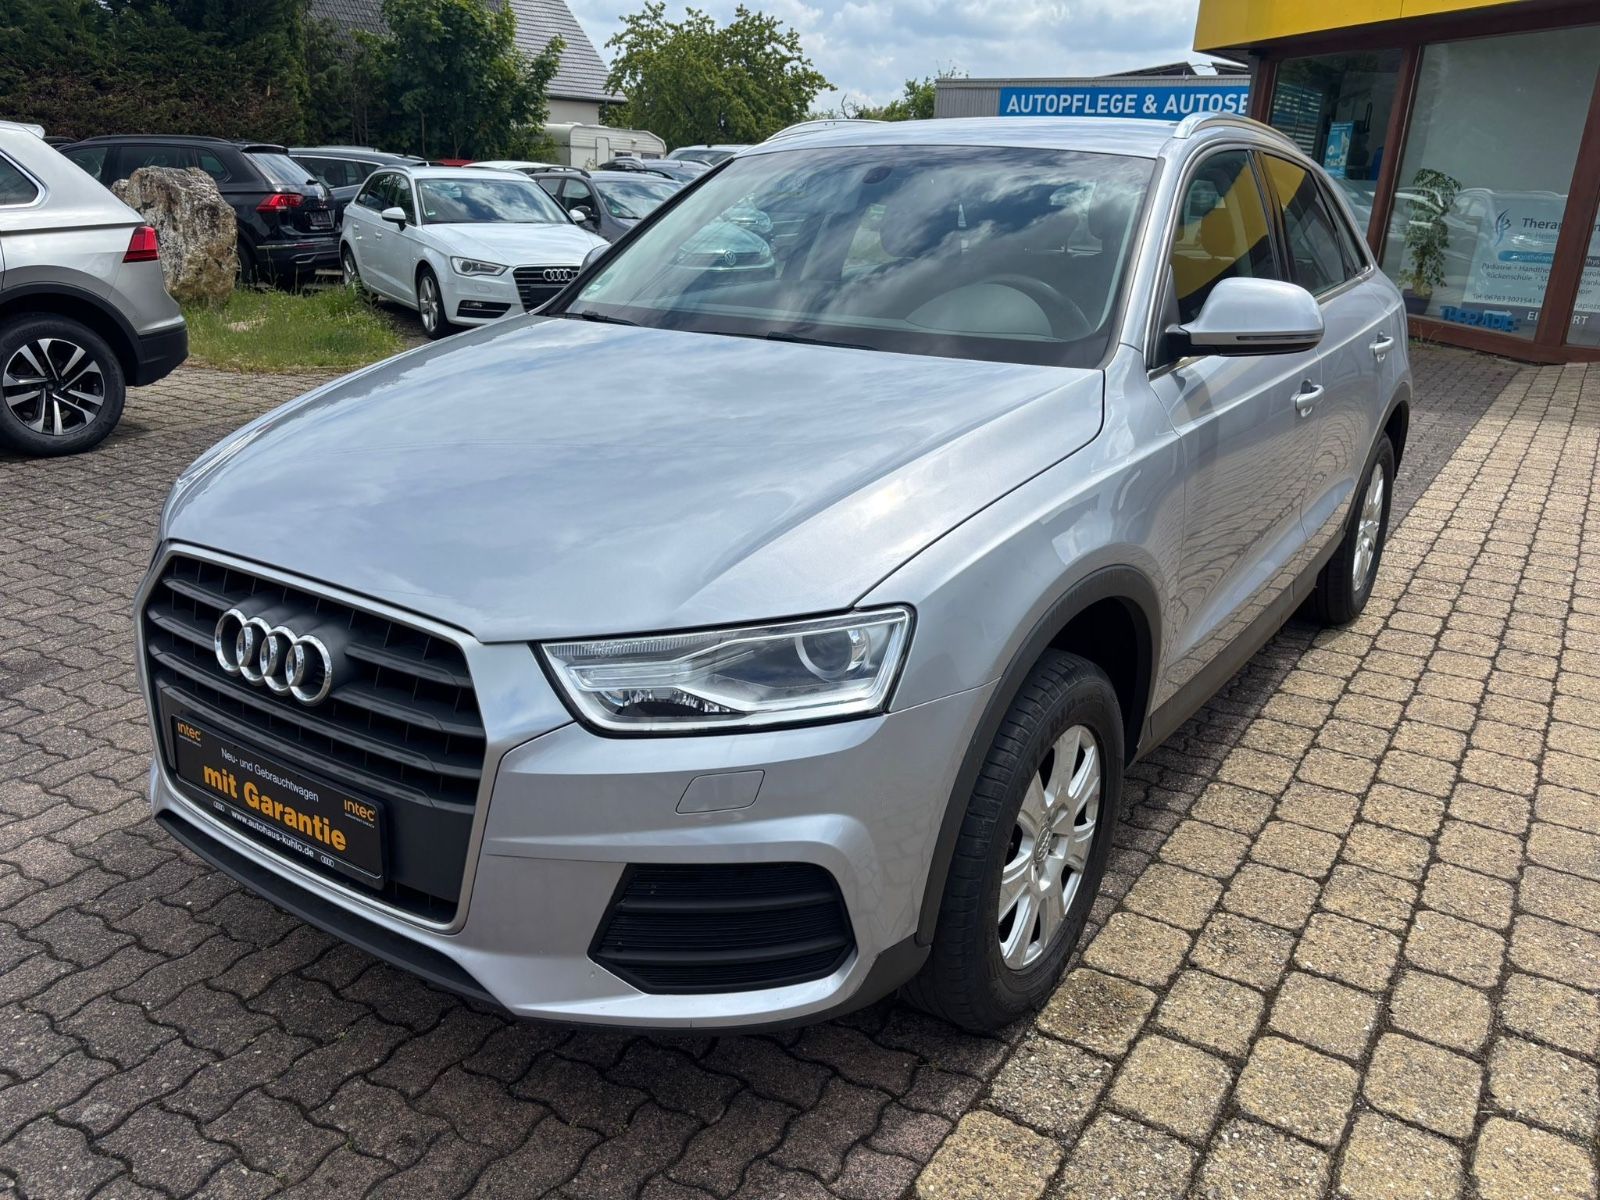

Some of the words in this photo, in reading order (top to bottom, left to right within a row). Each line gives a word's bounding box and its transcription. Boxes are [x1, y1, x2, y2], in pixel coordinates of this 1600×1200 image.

[1006, 93, 1138, 114] AUTOPFLEGE
[1142, 93, 1157, 114] &
[221, 747, 239, 764] Neu-
[239, 756, 253, 772] und
[254, 763, 319, 803] Gebrauchtwagen
[203, 764, 238, 799] mit
[243, 780, 347, 851] Garantie
[343, 799, 376, 822] intec
